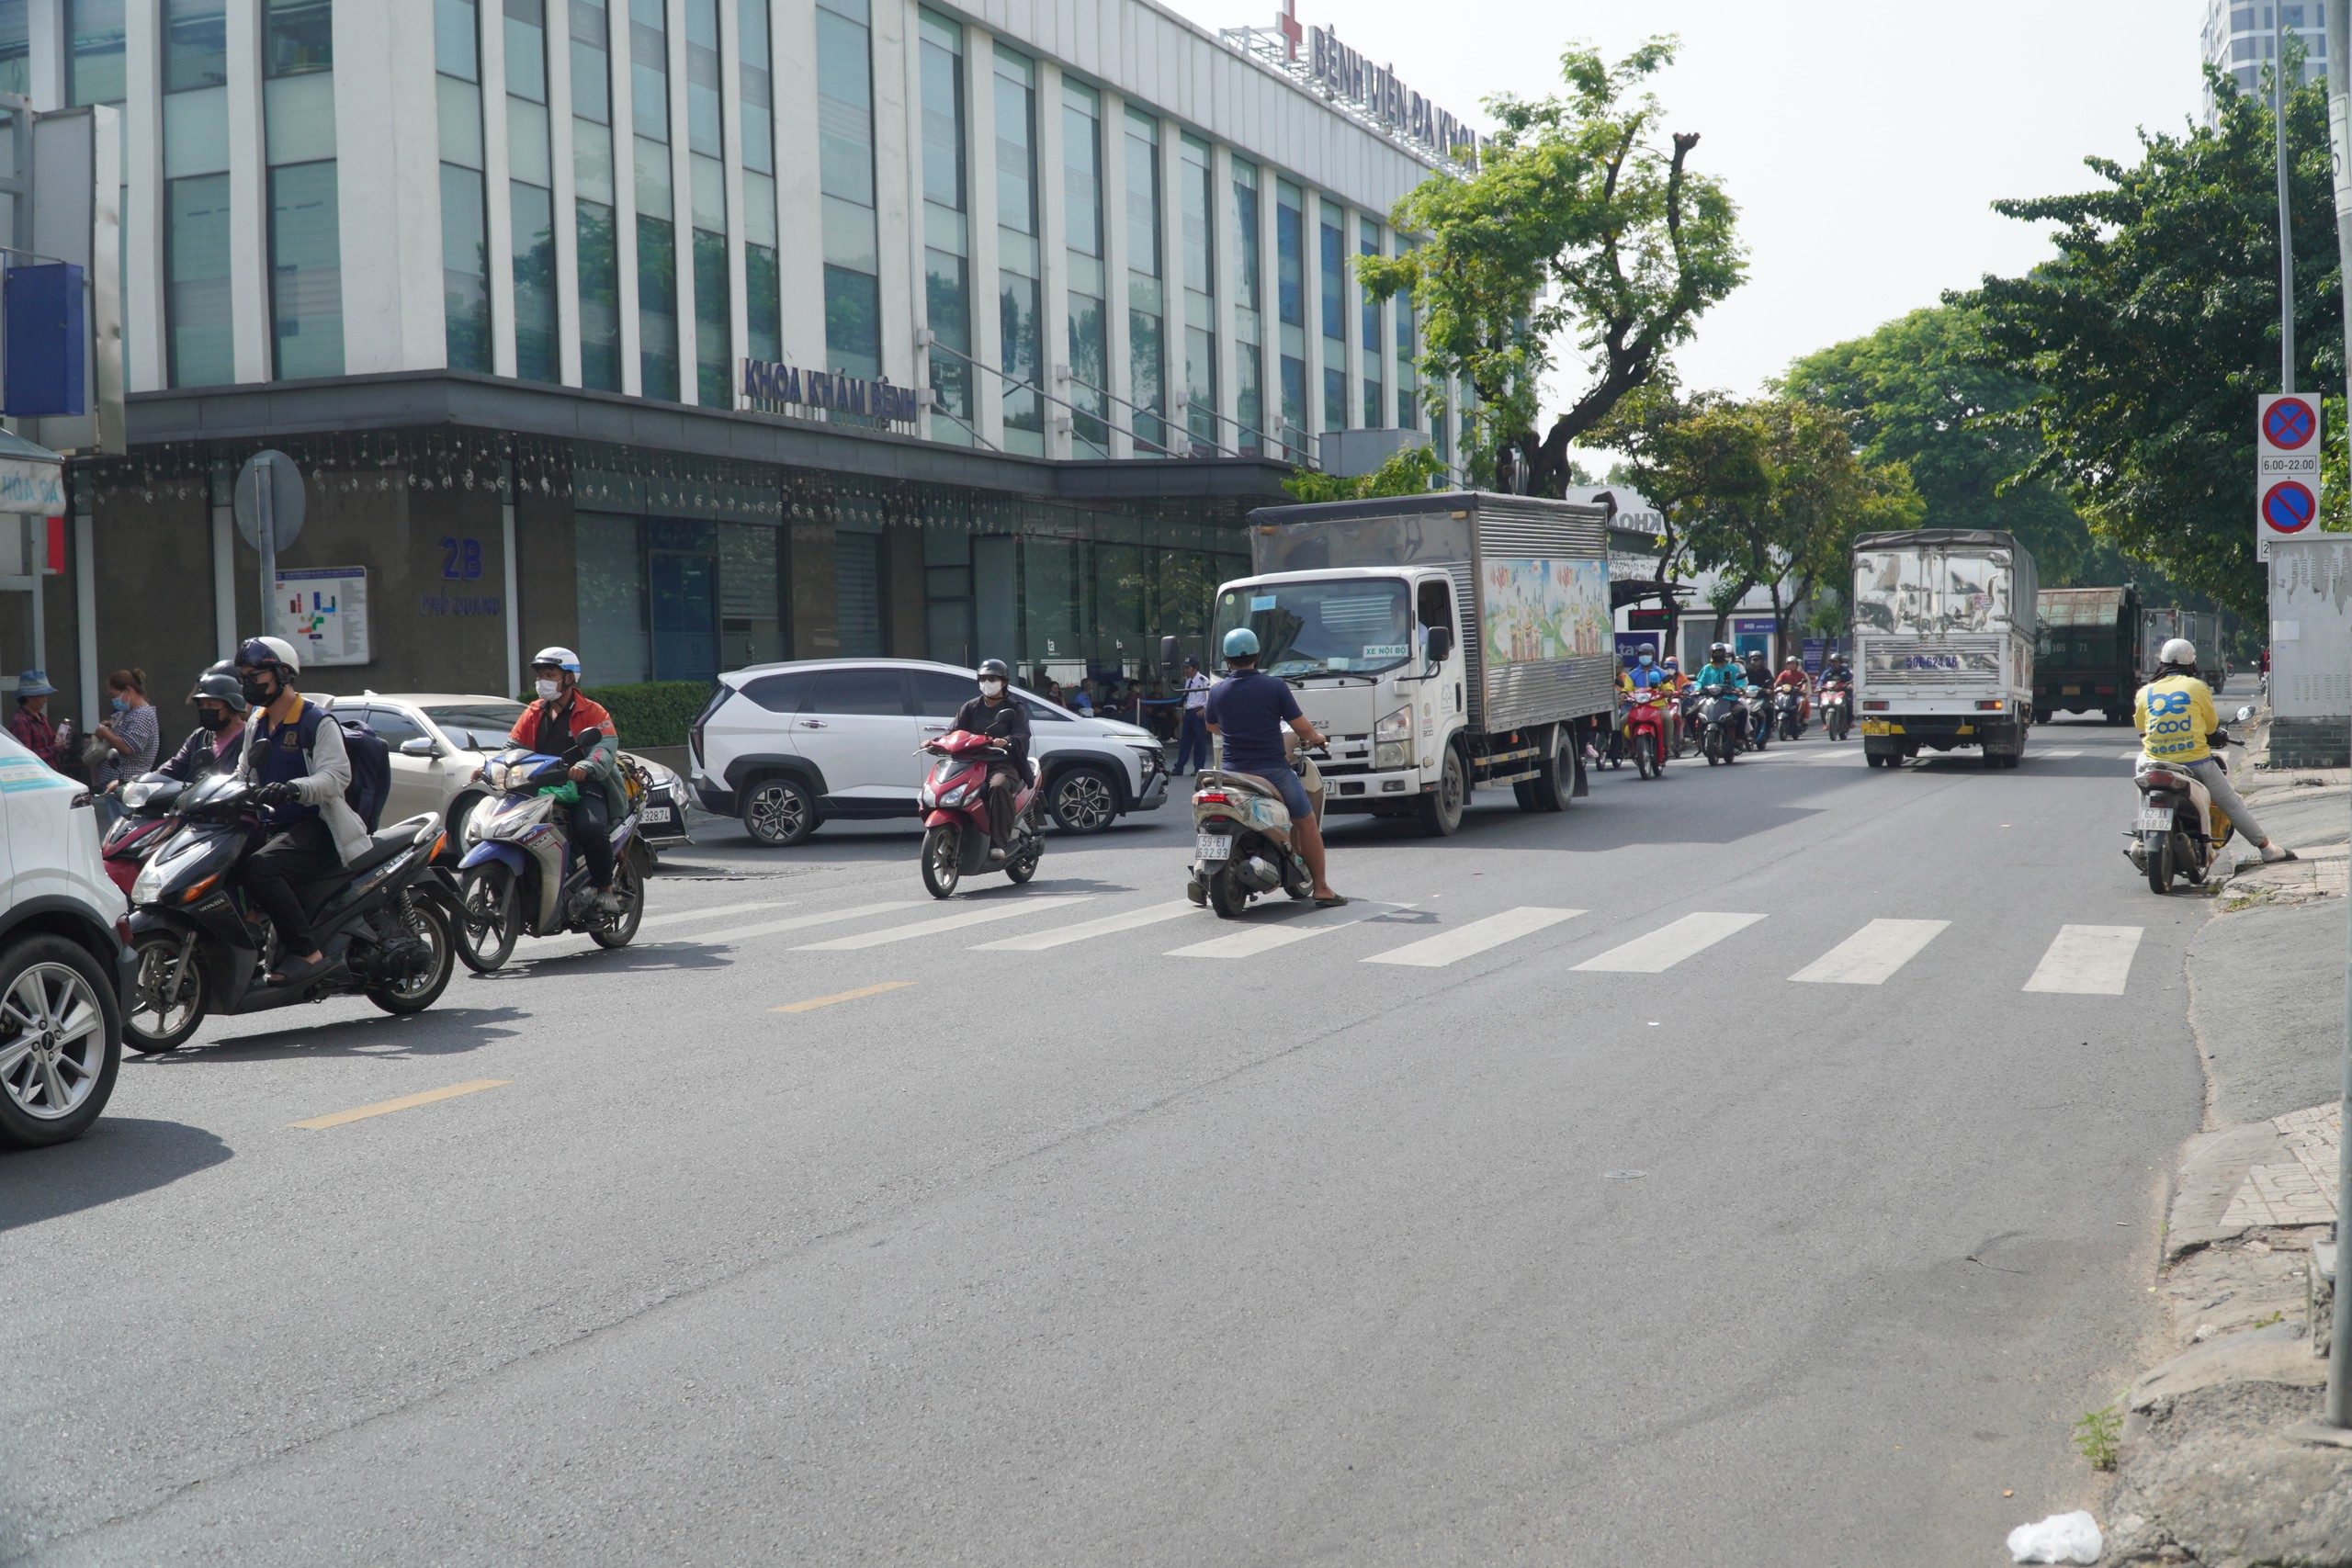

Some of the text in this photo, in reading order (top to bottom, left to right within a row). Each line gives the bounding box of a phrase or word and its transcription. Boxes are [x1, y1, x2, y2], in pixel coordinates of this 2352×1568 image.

[1308, 22, 1363, 103] BỆNH
[1363, 61, 1407, 135] VIỆN
[1407, 90, 1434, 147] ĐA
[739, 357, 801, 403] KHOA
[801, 367, 866, 414] KHÁM
[2264, 459, 2314, 471] 6:00-22:00
[440, 536, 483, 580] 2B
[455, 595, 502, 615] QUANG
[1378, 646, 1393, 656] NỘI
[1395, 645, 1407, 656] BỘ
[2147, 687, 2191, 716] be
[2149, 715, 2192, 736] Food
[640, 809, 669, 821] -328.74
[2141, 818, 2170, 829] 168.02
[1202, 838, 1226, 847] 59-E1
[1197, 848, 1227, 858] 632.93
[198, 898, 225, 912] HONDA
